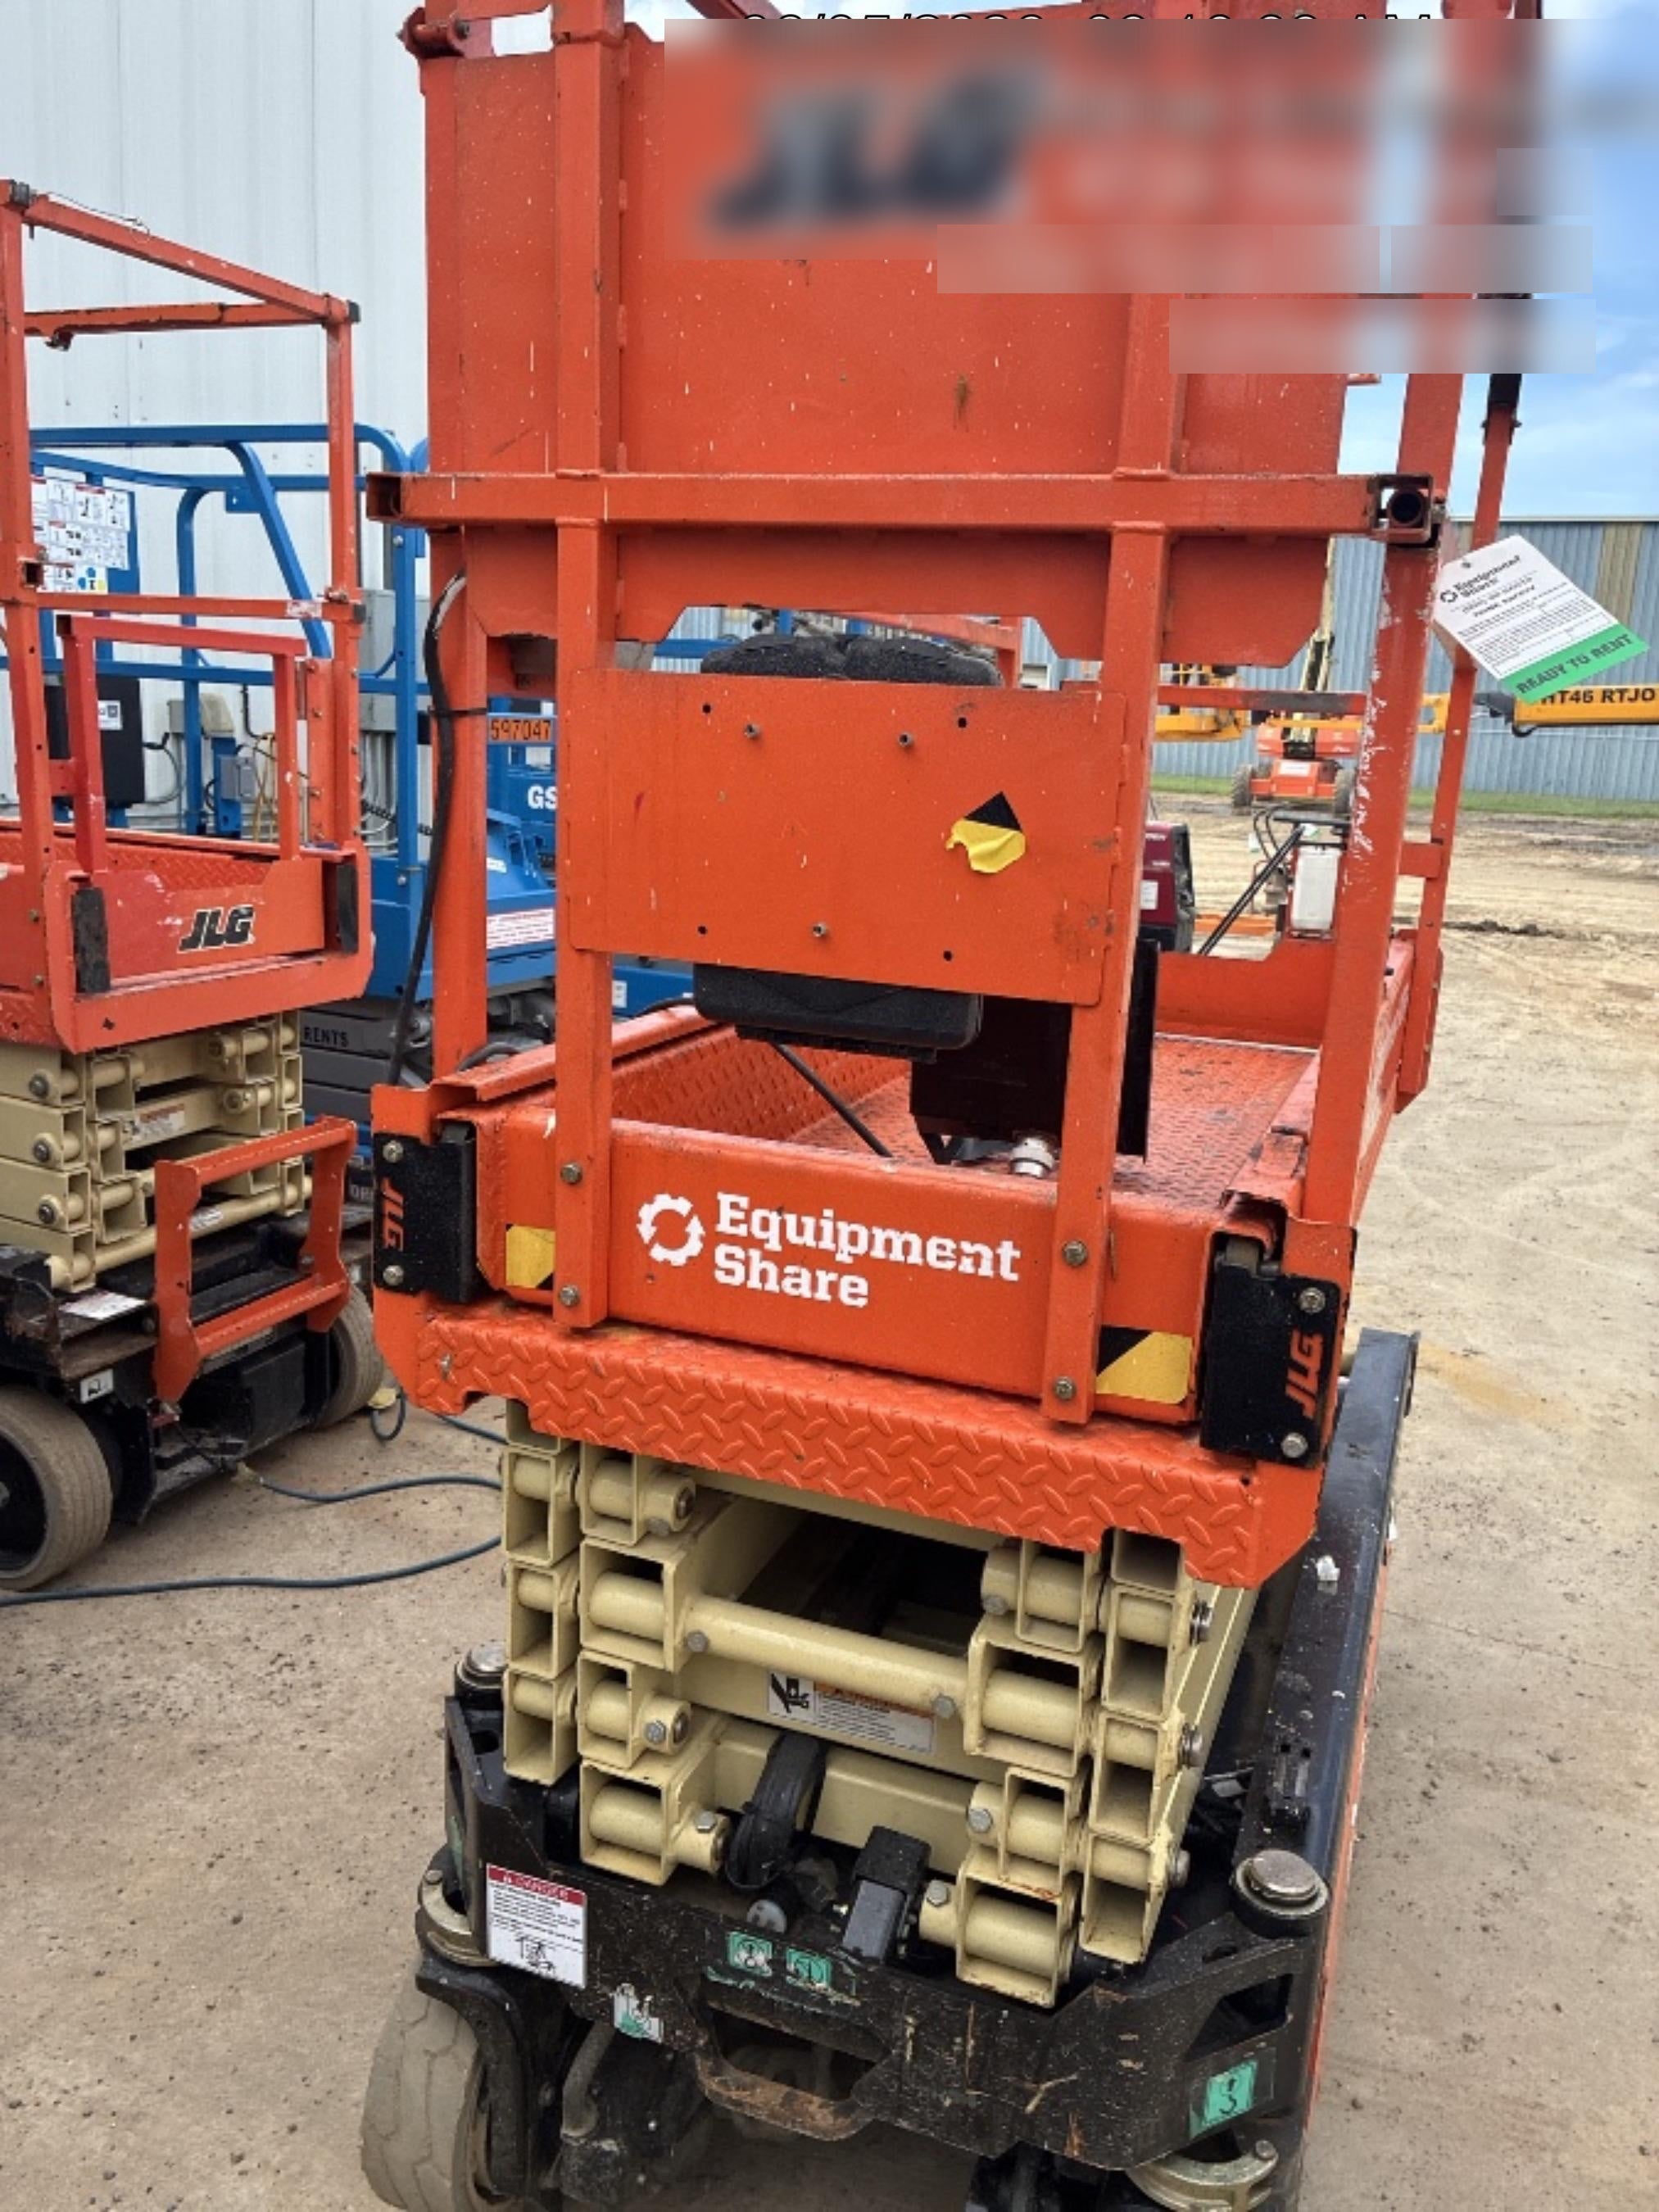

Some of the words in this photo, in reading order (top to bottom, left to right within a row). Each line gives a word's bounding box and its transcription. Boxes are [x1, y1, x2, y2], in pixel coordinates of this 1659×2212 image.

[1516, 663, 1567, 694] READY
[1566, 653, 1591, 668] TO
[1590, 633, 1633, 659] RENT
[177, 904, 256, 954] JLG
[380, 1176, 405, 1253] JLG
[715, 1191, 1022, 1282] Equipment
[714, 1243, 870, 1308] Share
[1285, 1329, 1325, 1419] JLG
